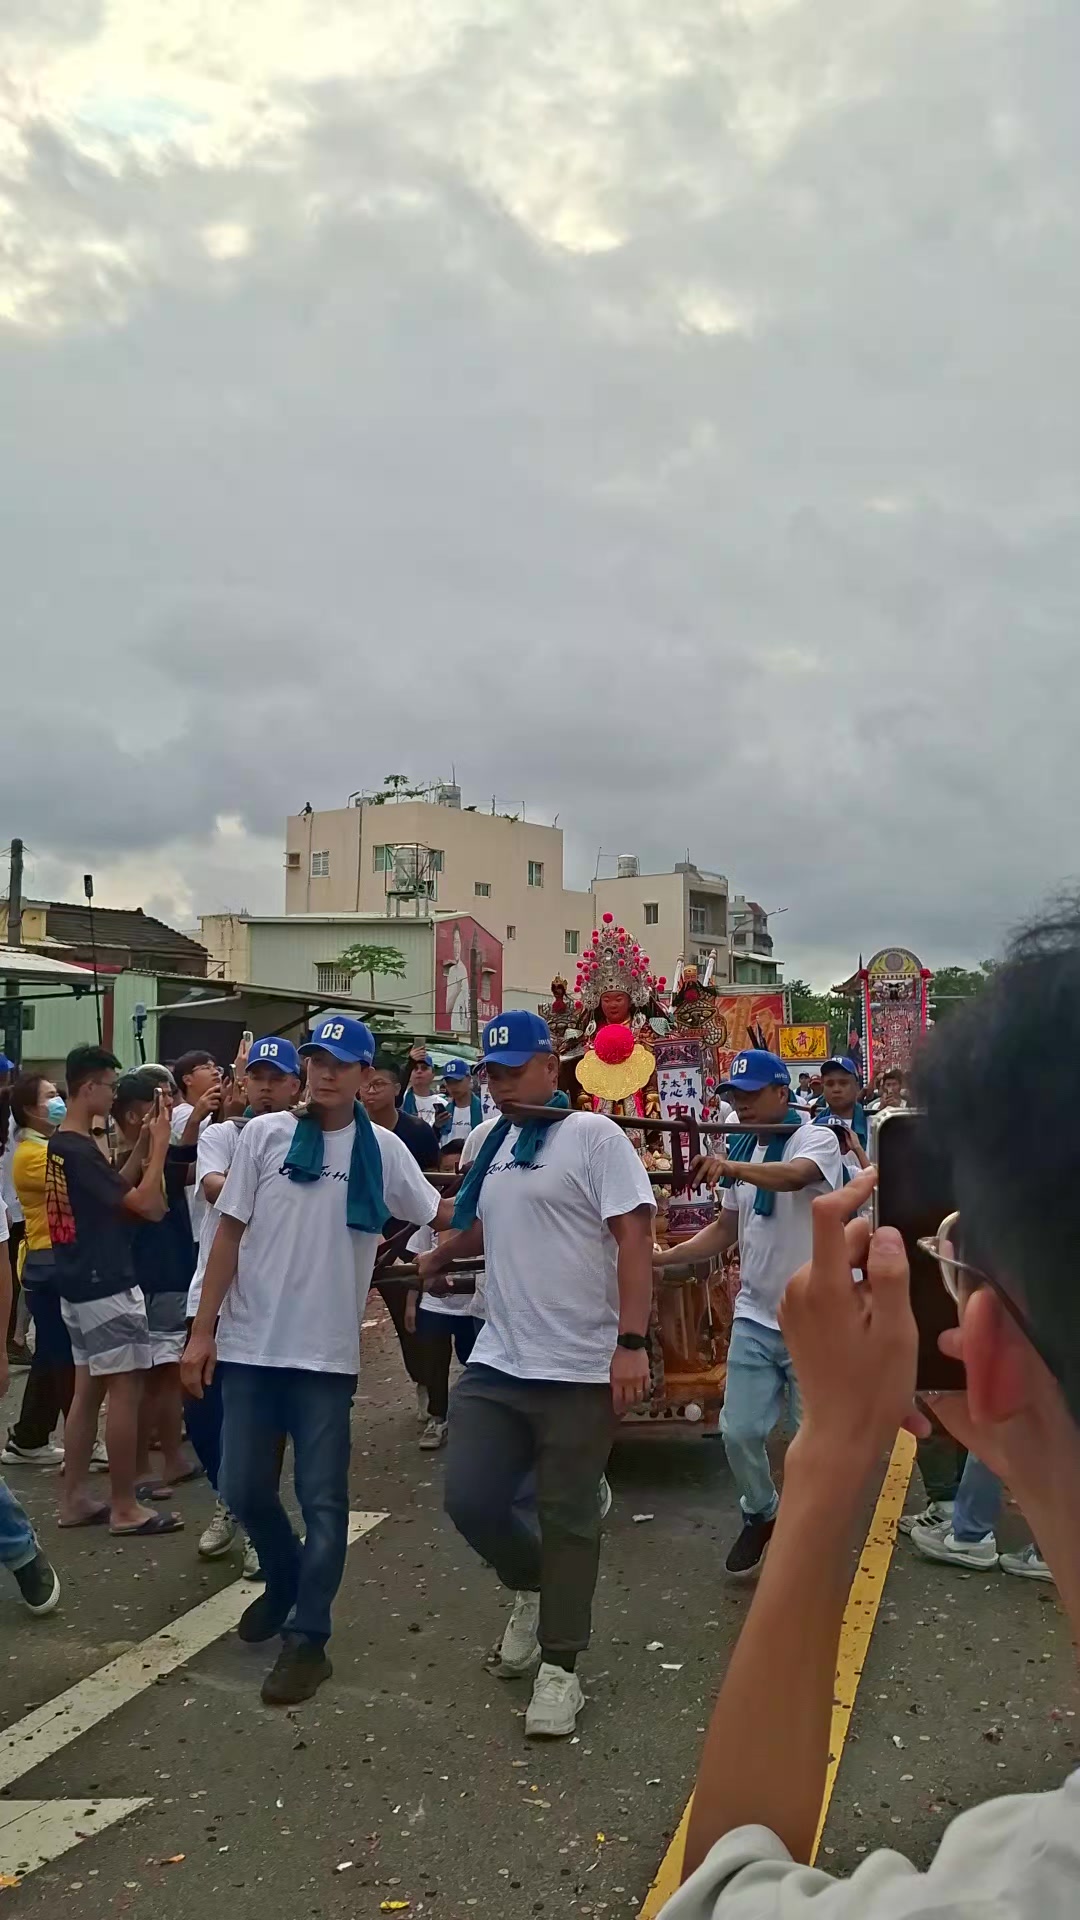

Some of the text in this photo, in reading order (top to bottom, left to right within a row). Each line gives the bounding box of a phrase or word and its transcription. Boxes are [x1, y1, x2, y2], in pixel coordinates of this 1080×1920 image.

[320, 1023, 345, 1040] 03
[489, 1026, 509, 1047] 03
[260, 1043, 278, 1057] 03
[446, 1063, 456, 1073] 03
[732, 1058, 748, 1076] 03
